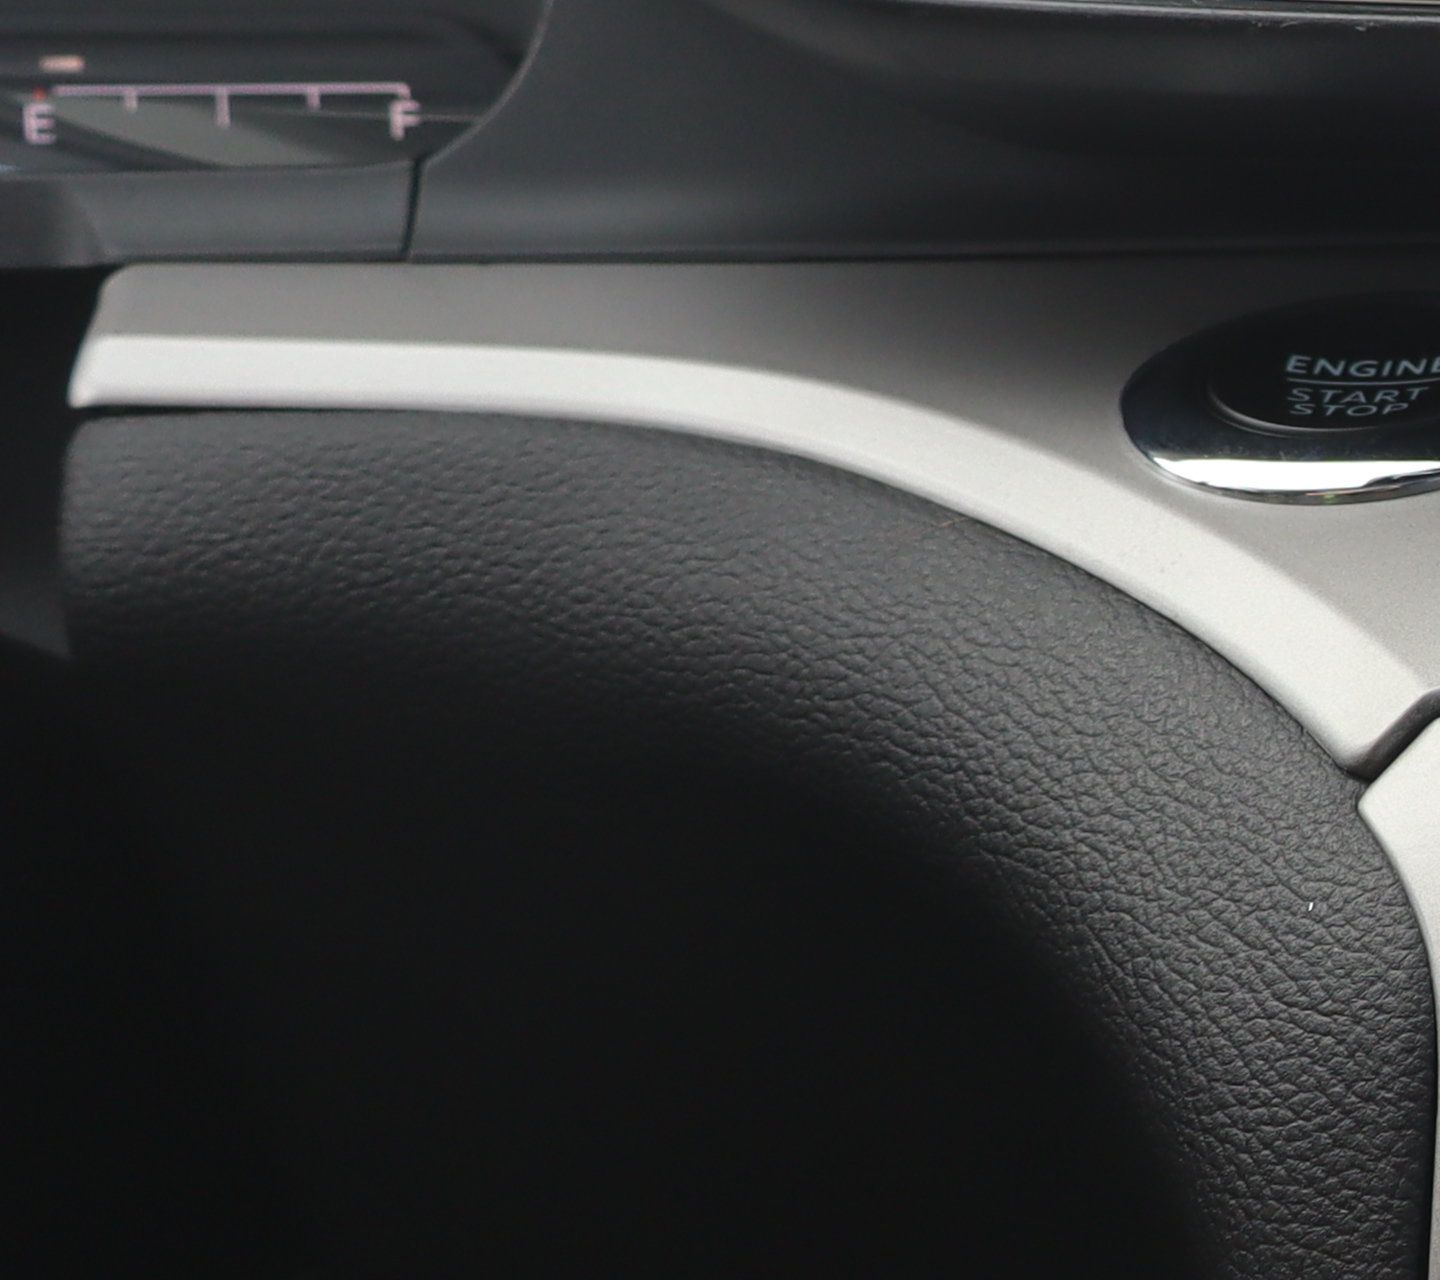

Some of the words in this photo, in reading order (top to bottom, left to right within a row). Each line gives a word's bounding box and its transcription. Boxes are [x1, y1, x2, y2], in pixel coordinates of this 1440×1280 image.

[23, 105, 56, 146] E
[389, 100, 420, 142] F
[1287, 385, 1430, 404] START
[1289, 401, 1410, 417] STOP
